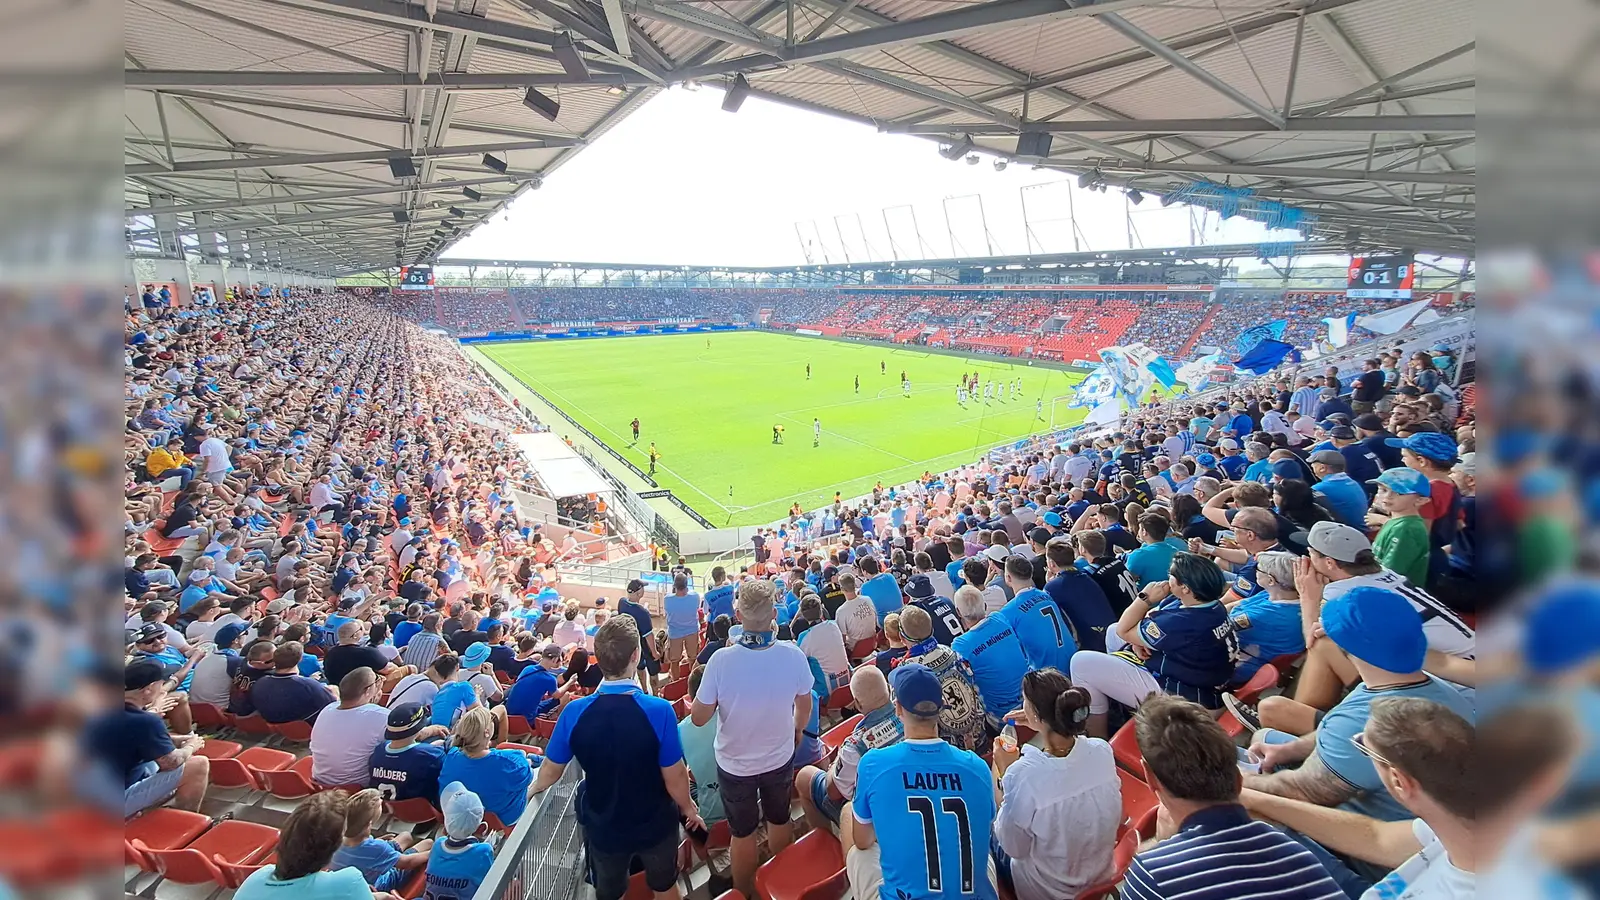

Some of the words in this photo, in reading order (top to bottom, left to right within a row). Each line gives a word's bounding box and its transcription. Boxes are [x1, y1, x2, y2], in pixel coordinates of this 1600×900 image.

[1363, 271, 1390, 284] 0-1
[943, 613, 964, 636] 9
[1039, 604, 1064, 648] 7
[972, 643, 986, 656] 1860
[985, 628, 1012, 647] MÜNCHEN
[372, 766, 407, 782] MÖLDERS
[902, 771, 963, 791] LAUTH
[906, 795, 974, 894] 11
[425, 872, 469, 889] EONHARD
